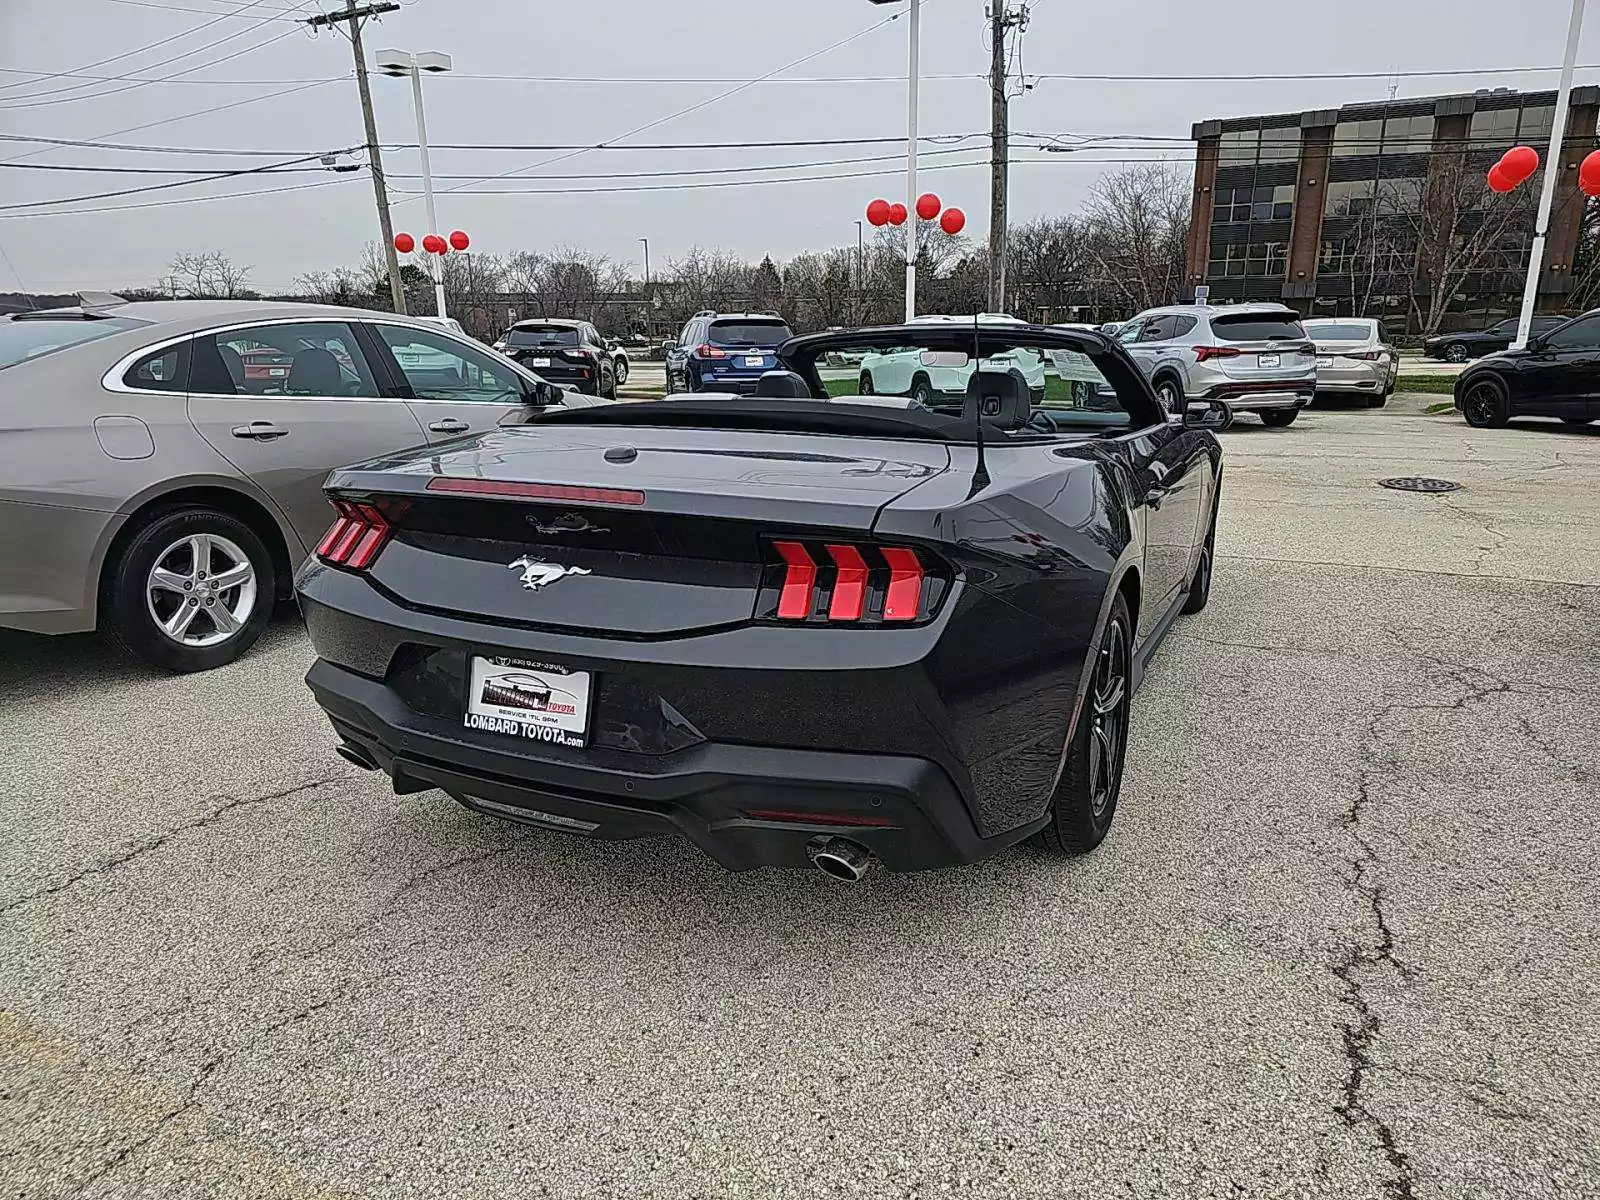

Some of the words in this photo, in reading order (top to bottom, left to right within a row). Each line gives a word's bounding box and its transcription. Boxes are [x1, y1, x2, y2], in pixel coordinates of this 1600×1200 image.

[548, 702, 576, 713] TOYOTA
[498, 709, 527, 719] SERVICE
[464, 713, 519, 735] LOMBARD
[520, 722, 584, 748] TOYOTA.com
